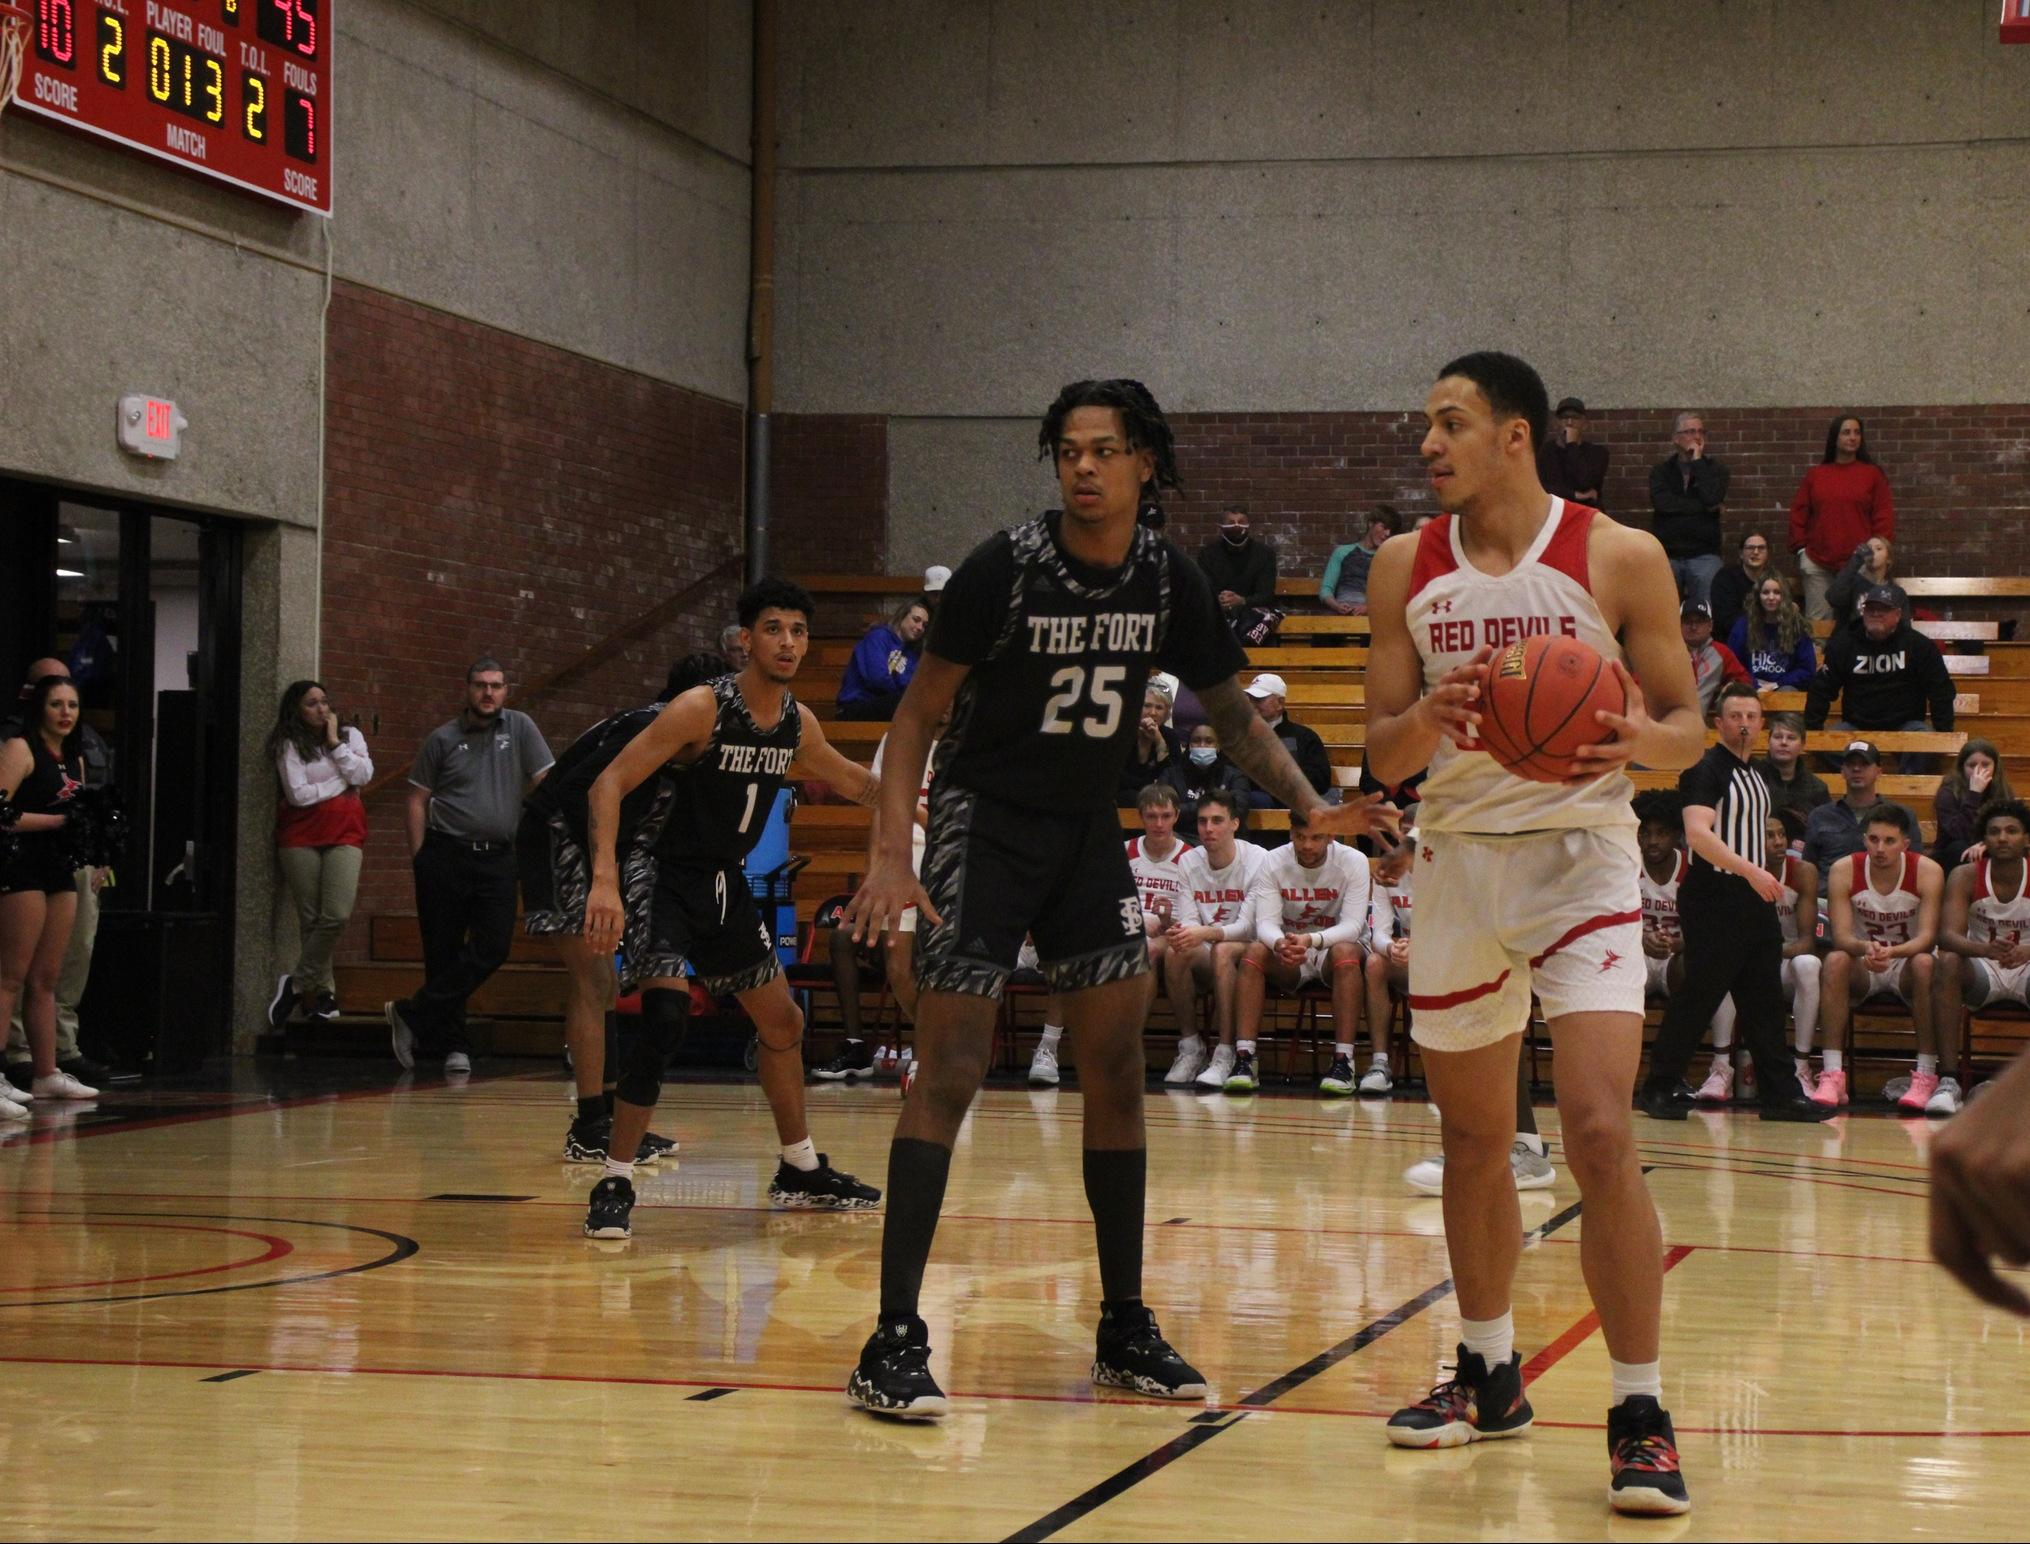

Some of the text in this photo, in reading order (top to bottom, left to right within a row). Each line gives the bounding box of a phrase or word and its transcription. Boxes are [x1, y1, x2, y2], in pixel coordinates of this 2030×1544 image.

[103, 16, 122, 82] 2
[146, 1, 227, 57] PLAYER FOUL
[34, 72, 79, 112] SCORE
[284, 61, 318, 96] FOULS
[247, 78, 265, 138] 2
[300, 99, 315, 154] 7
[166, 123, 207, 160] MATCH
[284, 168, 318, 201] SCORE
[1027, 612, 1157, 654] THE FORT
[1429, 619, 1475, 653] RED
[1852, 650, 1905, 674] ZION
[1039, 665, 1126, 738] 25
[718, 744, 756, 773] THE
[738, 783, 758, 833] 1
[1281, 888, 1340, 902] ALLEN
